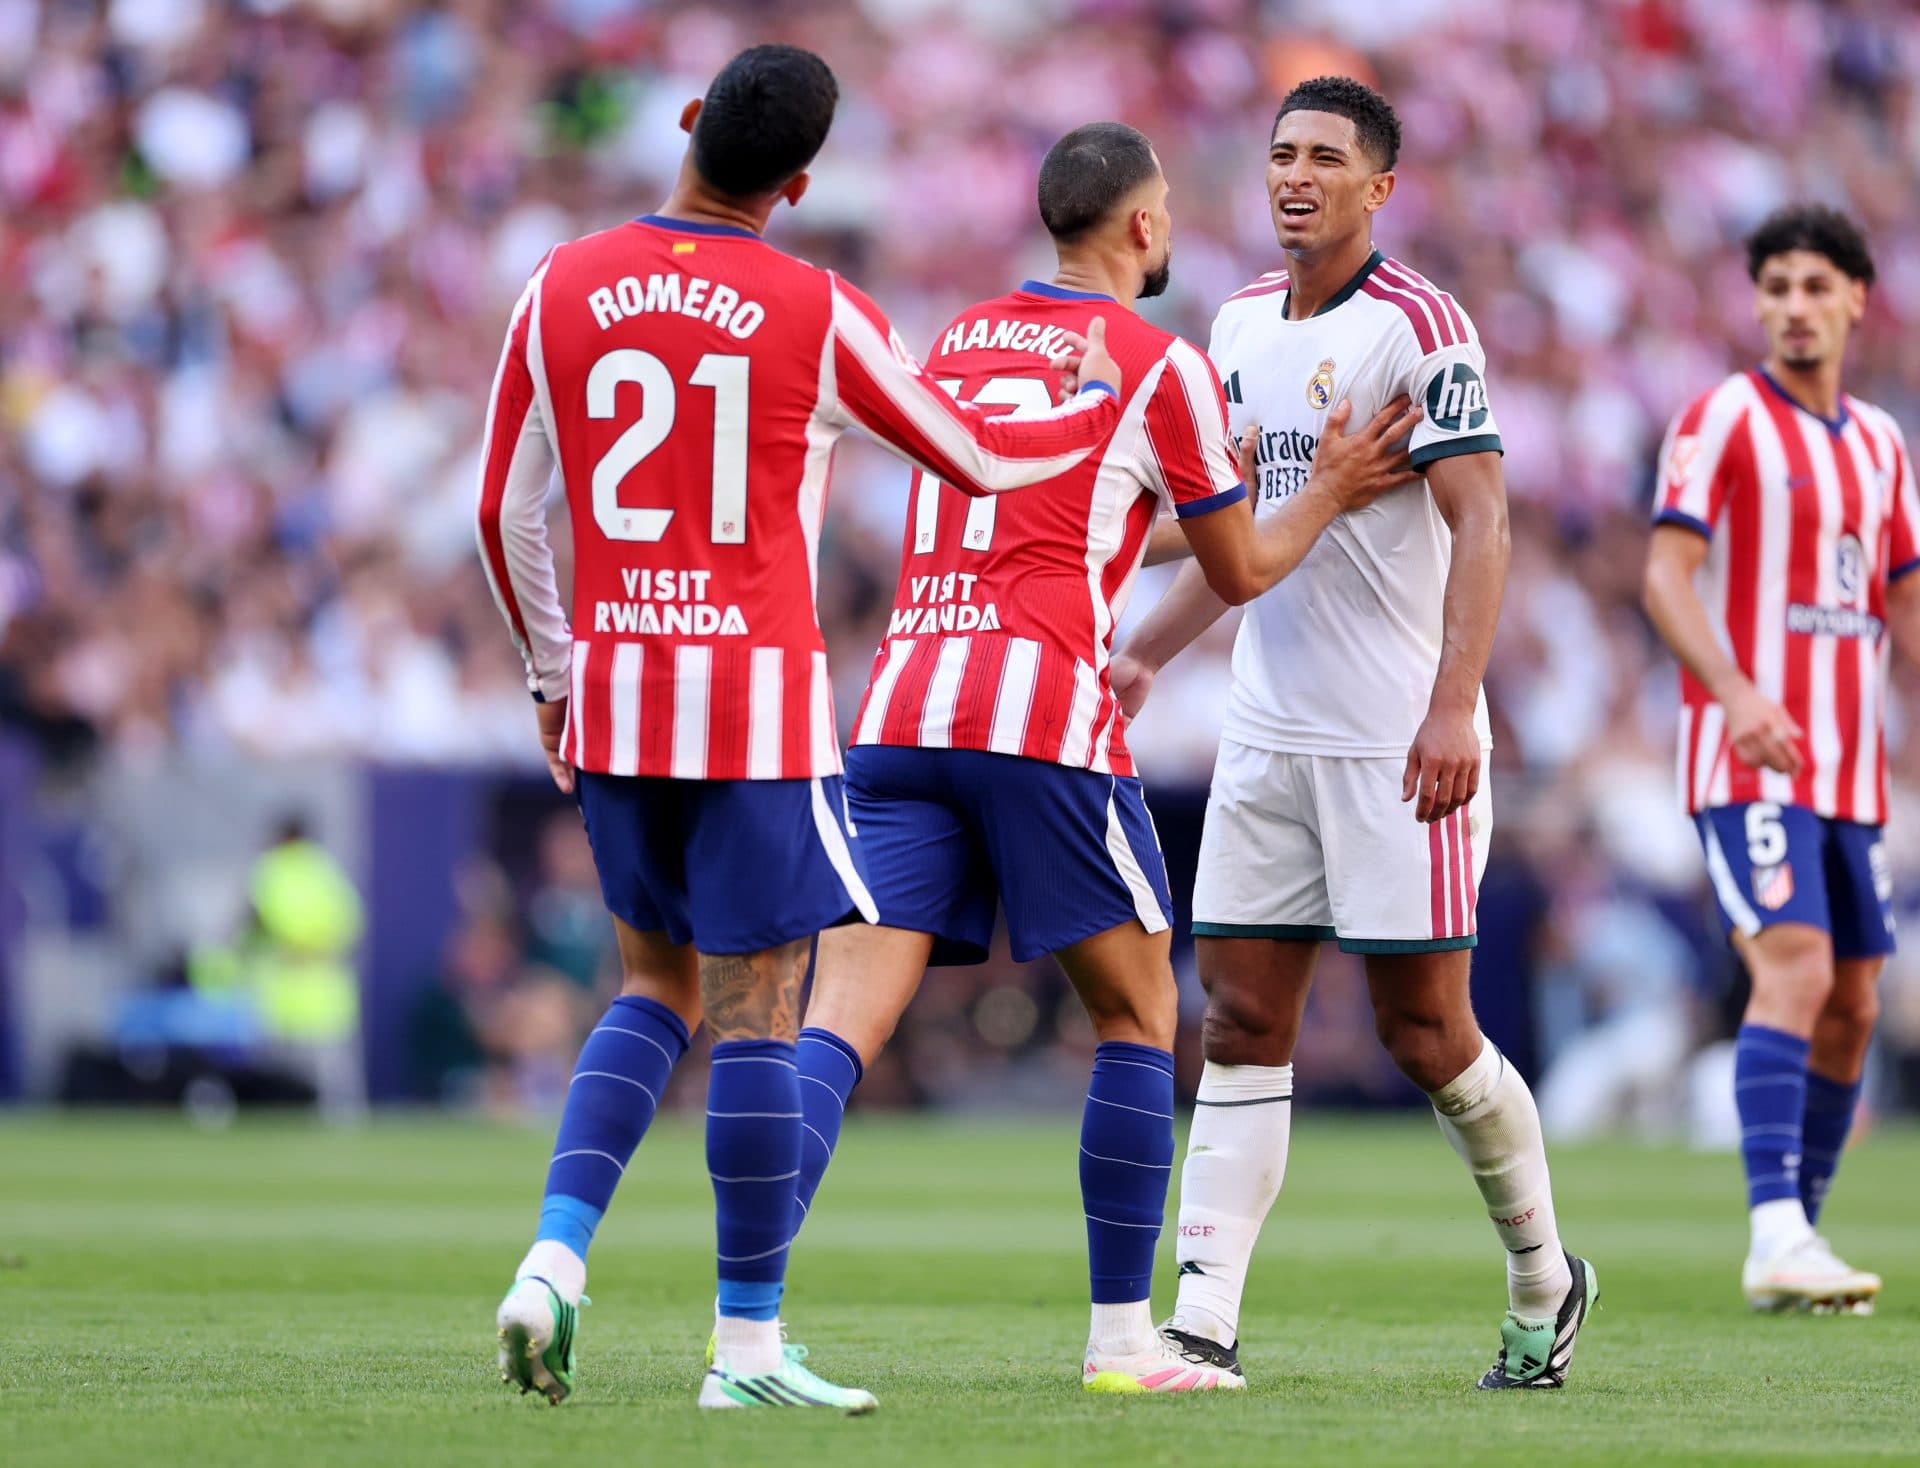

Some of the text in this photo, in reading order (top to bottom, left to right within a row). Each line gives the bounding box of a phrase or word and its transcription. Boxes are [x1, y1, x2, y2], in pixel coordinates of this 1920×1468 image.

[586, 273, 765, 340] ROMERO
[1433, 363, 1483, 432] hp
[586, 348, 751, 545] 21
[621, 568, 712, 601] VISIT
[594, 602, 750, 636] RWANDA
[886, 603, 1002, 640] WANDA
[1744, 801, 1788, 867] 5
[1491, 1207, 1536, 1228] MCF
